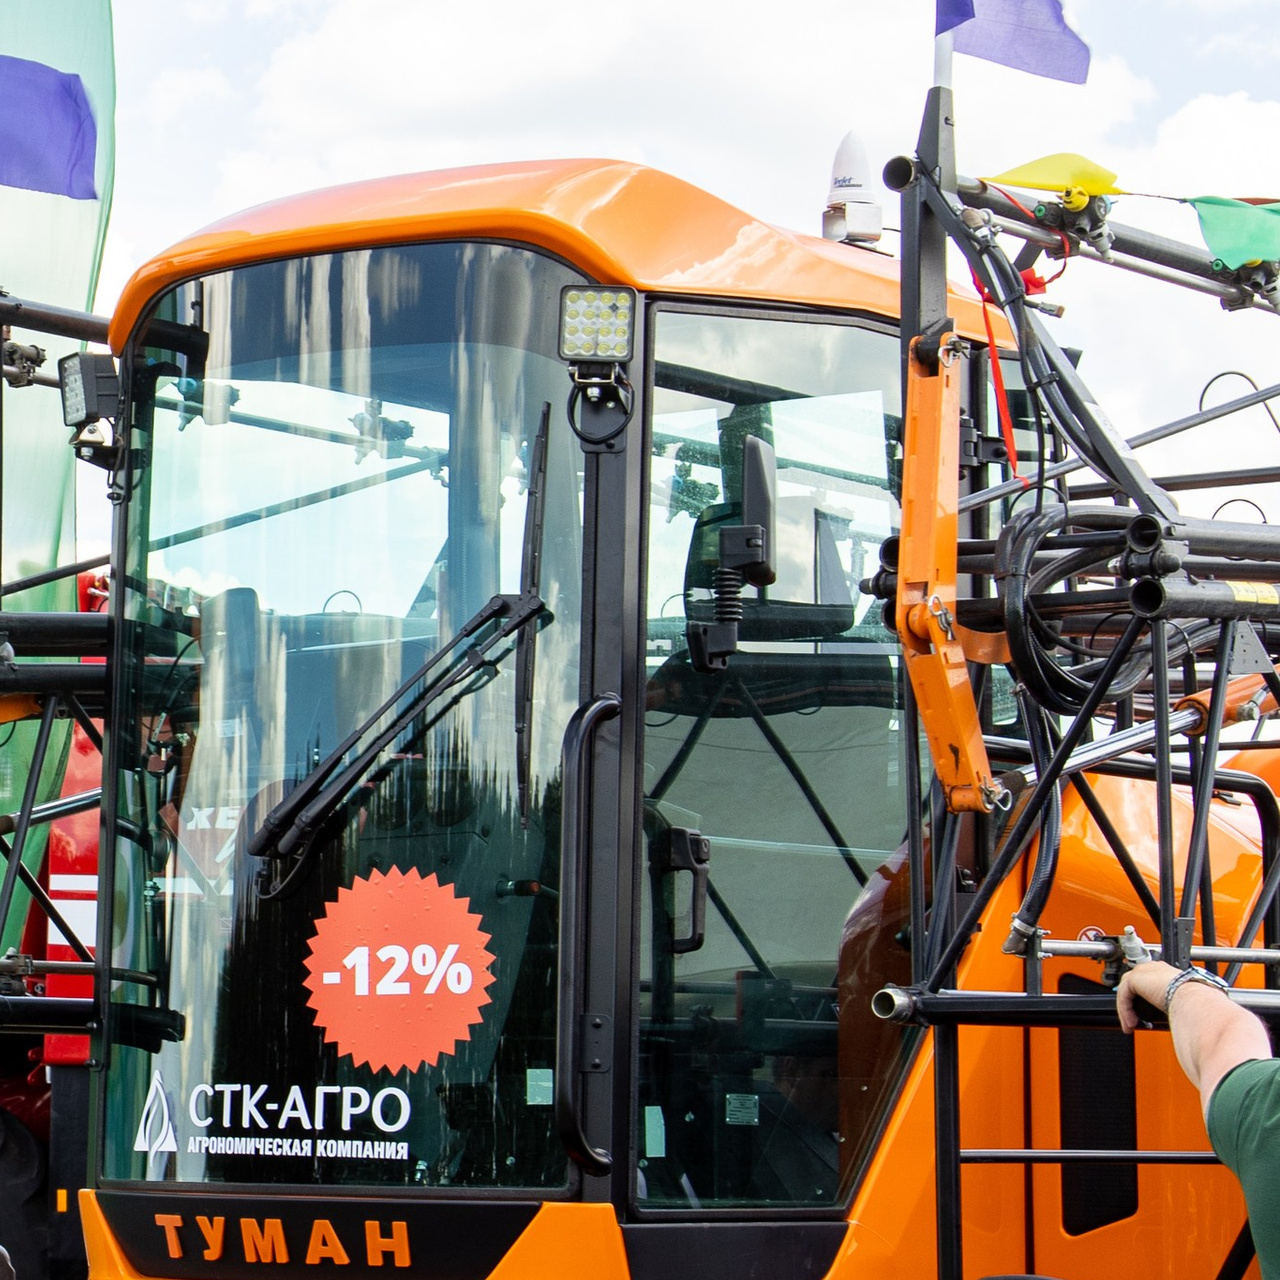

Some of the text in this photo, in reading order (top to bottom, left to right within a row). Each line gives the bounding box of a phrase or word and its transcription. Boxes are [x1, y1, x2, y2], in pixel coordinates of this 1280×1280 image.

[323, 944, 473, 995] -12%
[189, 1084, 411, 1133] СТК-АГРО
[187, 1136, 409, 1160] АГРОНОМИЧЕСКАЯ КОМПАНИЯ
[154, 1214, 411, 1268] ТУМАН
